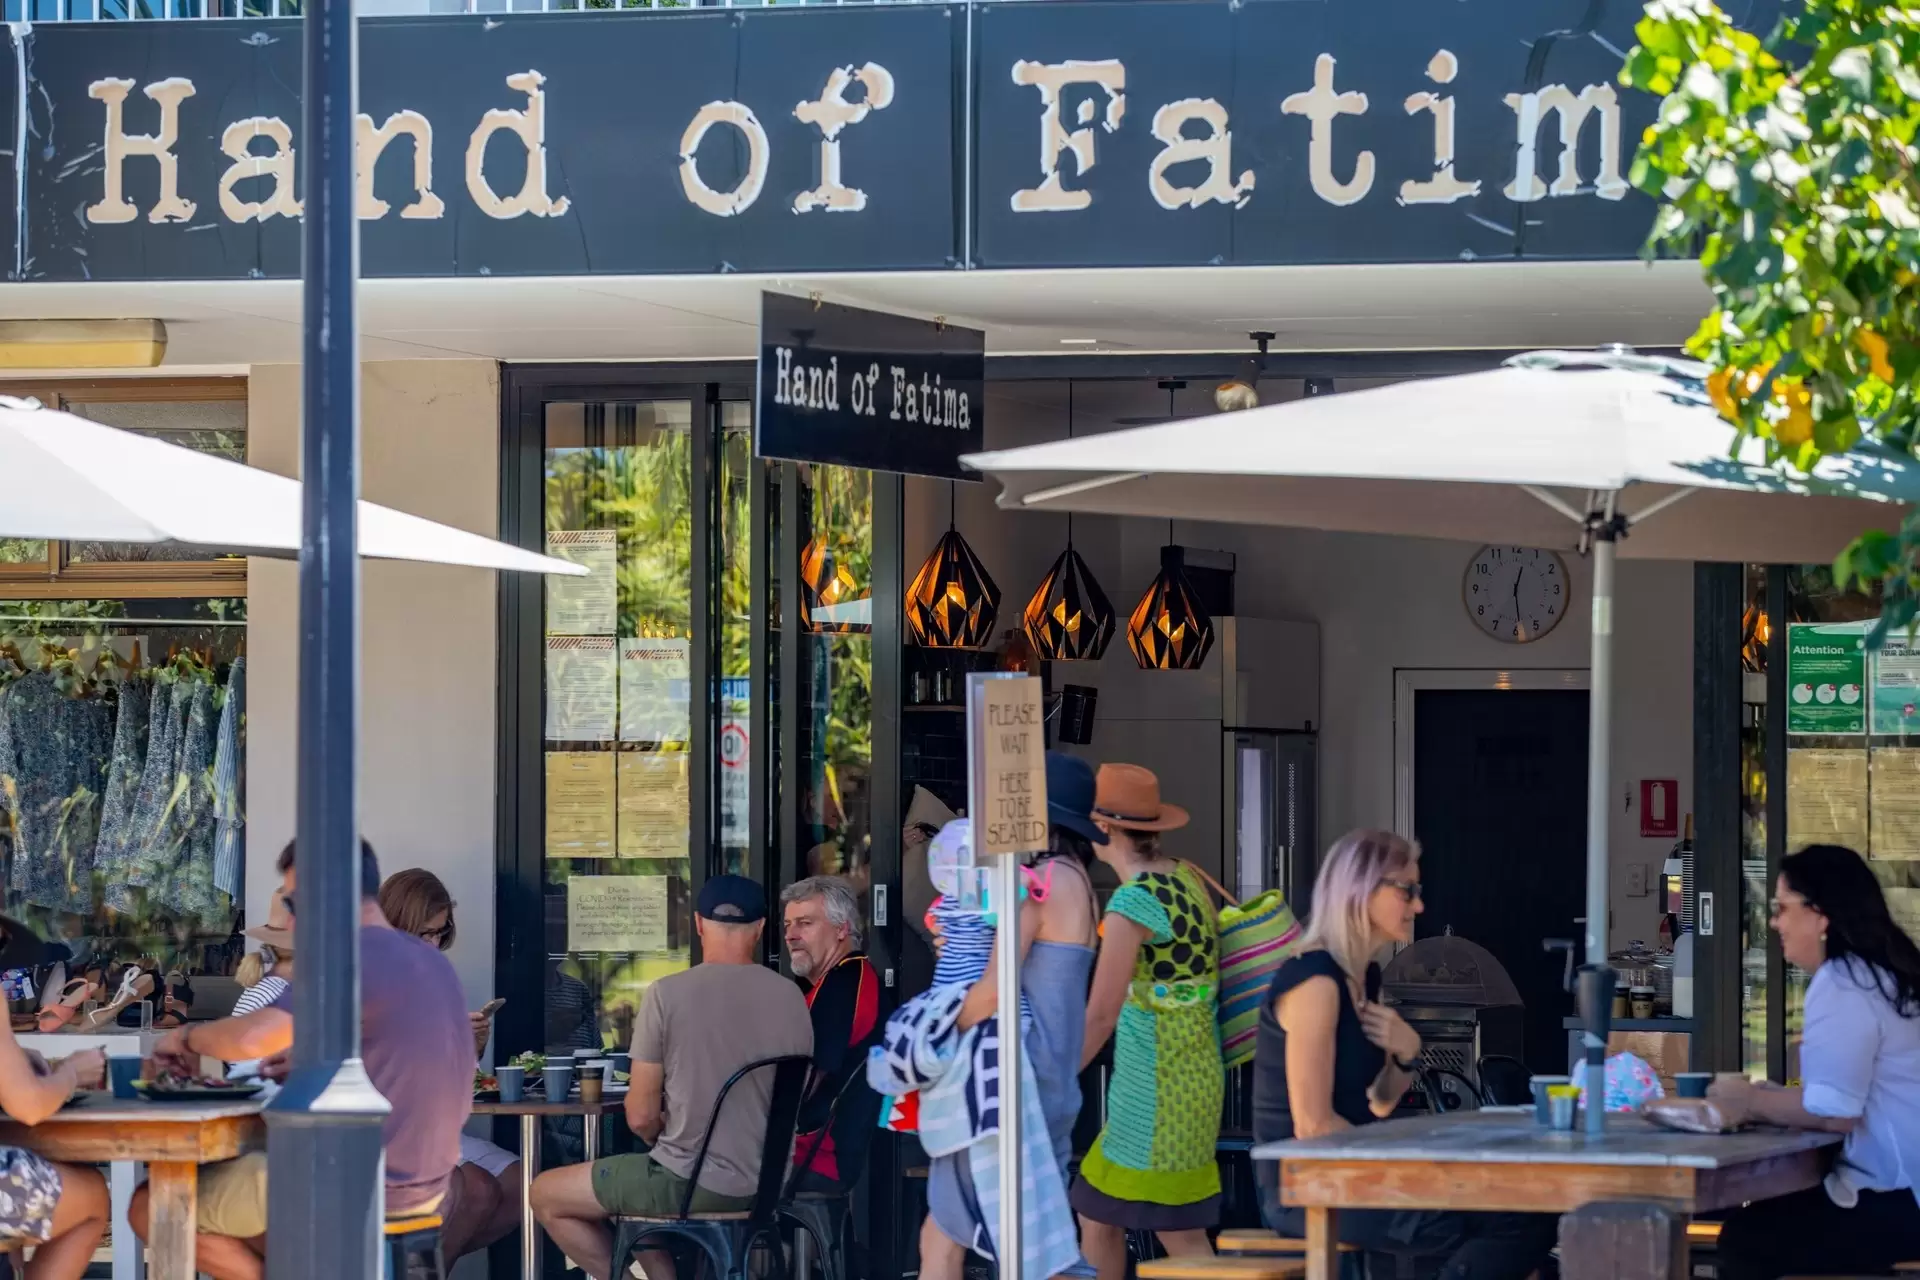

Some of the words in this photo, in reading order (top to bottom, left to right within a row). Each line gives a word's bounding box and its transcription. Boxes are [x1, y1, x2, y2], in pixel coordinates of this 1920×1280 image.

[87, 69, 571, 224] Hand
[679, 61, 895, 217] of
[1011, 48, 1690, 213] Fatim
[774, 347, 840, 412] Hand
[851, 362, 880, 416] of
[889, 365, 972, 431] Fatima
[1491, 549, 1501, 559] 11
[1476, 563, 1488, 574] 10
[1548, 563, 1555, 574] 2
[1472, 584, 1479, 594] 9
[1553, 584, 1560, 595] 3
[1477, 604, 1485, 615] 8
[1548, 605, 1555, 615] 4
[1492, 620, 1499, 631] 7
[1512, 625, 1519, 636] 6
[1533, 620, 1540, 631] 5
[1792, 645, 1845, 655] Attention
[988, 703, 1039, 727] PLEASE
[1000, 732, 1030, 755] WAIT
[999, 771, 1032, 794] HERE
[986, 820, 1046, 846] SEATED
